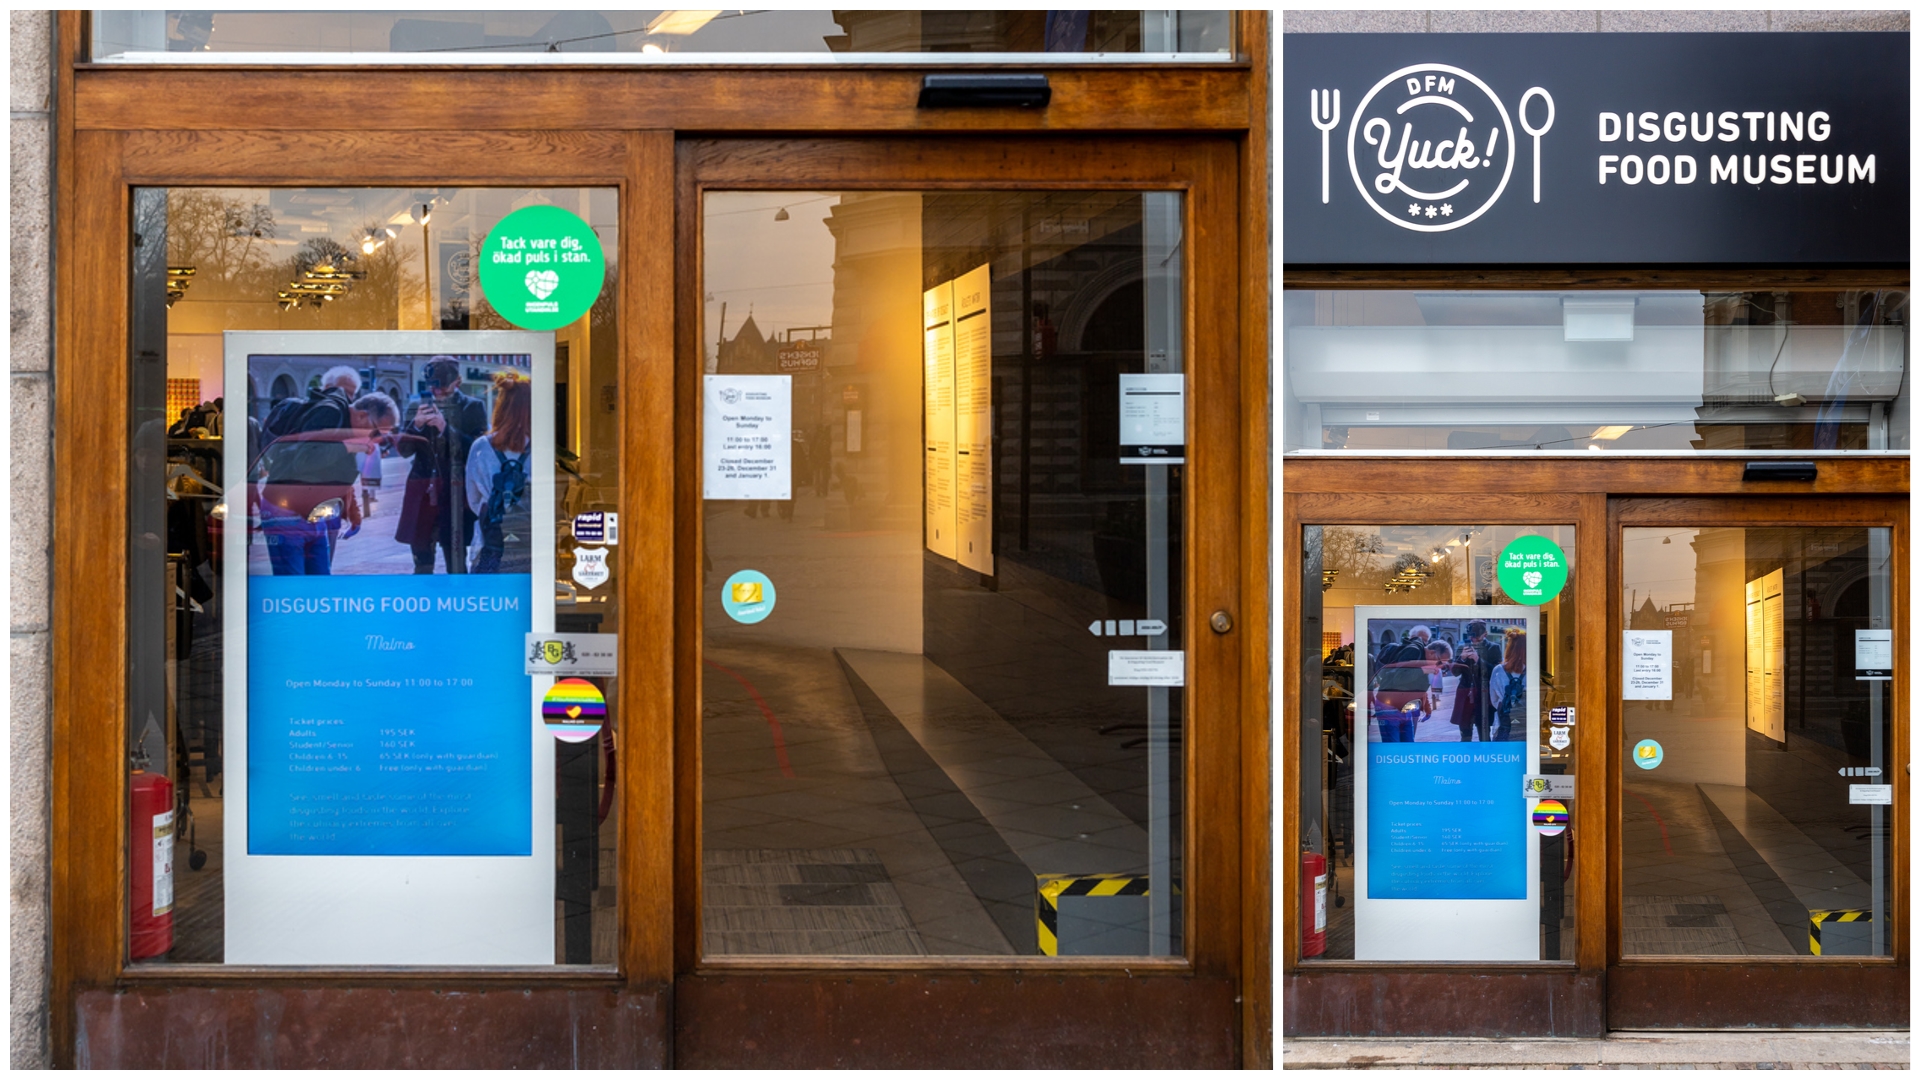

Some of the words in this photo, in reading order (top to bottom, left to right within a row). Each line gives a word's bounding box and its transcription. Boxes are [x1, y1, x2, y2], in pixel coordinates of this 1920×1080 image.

[1406, 75, 1455, 96] DFM
[1598, 111, 1832, 143] DISGUSTING
[1363, 117, 1499, 195] Yuck!
[1598, 154, 1697, 186] FOOD
[1710, 153, 1877, 186] MUSEUM
[500, 236, 526, 249] Tack
[530, 239, 557, 249] vare
[561, 236, 583, 251] dig,
[492, 250, 522, 264] ökad
[525, 250, 550, 266] puls
[554, 250, 558, 263] i
[561, 251, 591, 263] stan.
[577, 512, 602, 522] rapid
[1509, 552, 1524, 560] Tack
[1523, 560, 1537, 569] puls
[262, 597, 375, 613] DISGUSTING
[380, 597, 431, 613] FOOD
[437, 596, 520, 612] MUSEUM
[286, 678, 311, 689] Open
[313, 678, 350, 689] Monday
[353, 679, 363, 687] to
[366, 678, 402, 689] Sunday
[433, 678, 443, 686] to
[289, 717, 315, 725] Ticket
[380, 728, 396, 737] 195
[397, 728, 416, 737] SEK
[289, 741, 354, 749] Student/Senior
[380, 740, 396, 748] 160
[397, 740, 416, 748] SEK
[289, 753, 326, 761] Children
[327, 753, 348, 761] 615
[392, 752, 409, 760] SEK
[1376, 754, 1439, 764] DISGUSTING
[1442, 754, 1471, 764] FOOD
[1474, 754, 1520, 763] MUSEUM
[289, 764, 326, 772] Children
[327, 764, 352, 772] under
[355, 764, 361, 772] 6
[379, 764, 398, 772] Free
